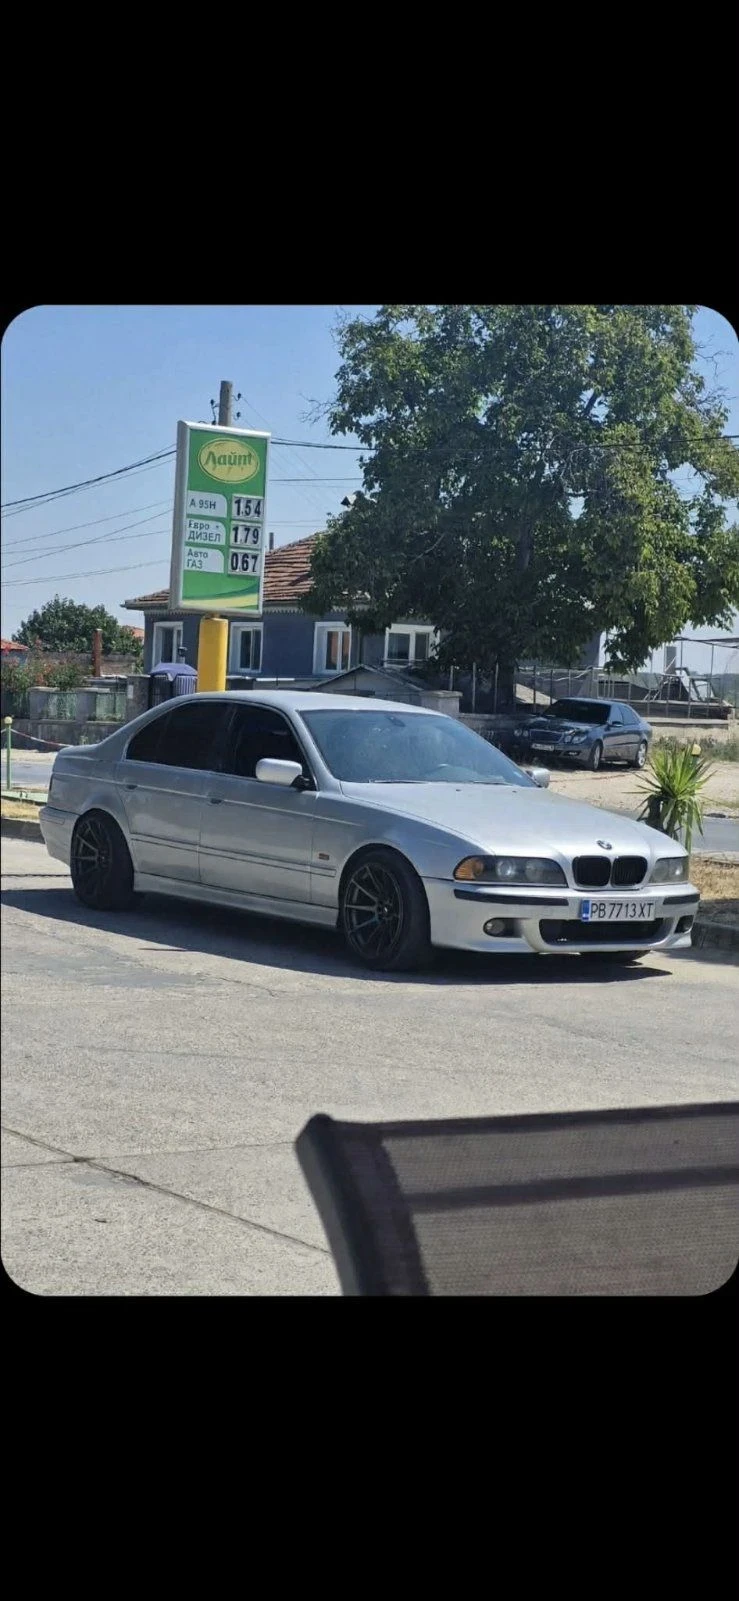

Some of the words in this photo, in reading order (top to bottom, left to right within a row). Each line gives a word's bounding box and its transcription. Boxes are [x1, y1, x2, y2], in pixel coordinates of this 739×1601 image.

[189, 499, 196, 507] А
[235, 499, 262, 517] 1.54
[188, 520, 210, 530] Евро
[188, 531, 221, 542] ДИЗЕЛ
[233, 526, 259, 545] 1.79
[187, 548, 208, 558] Авто
[187, 559, 203, 569] ГАЗ
[591, 903, 606, 918] PB
[609, 903, 636, 918] 7713
[638, 903, 654, 918] XT
